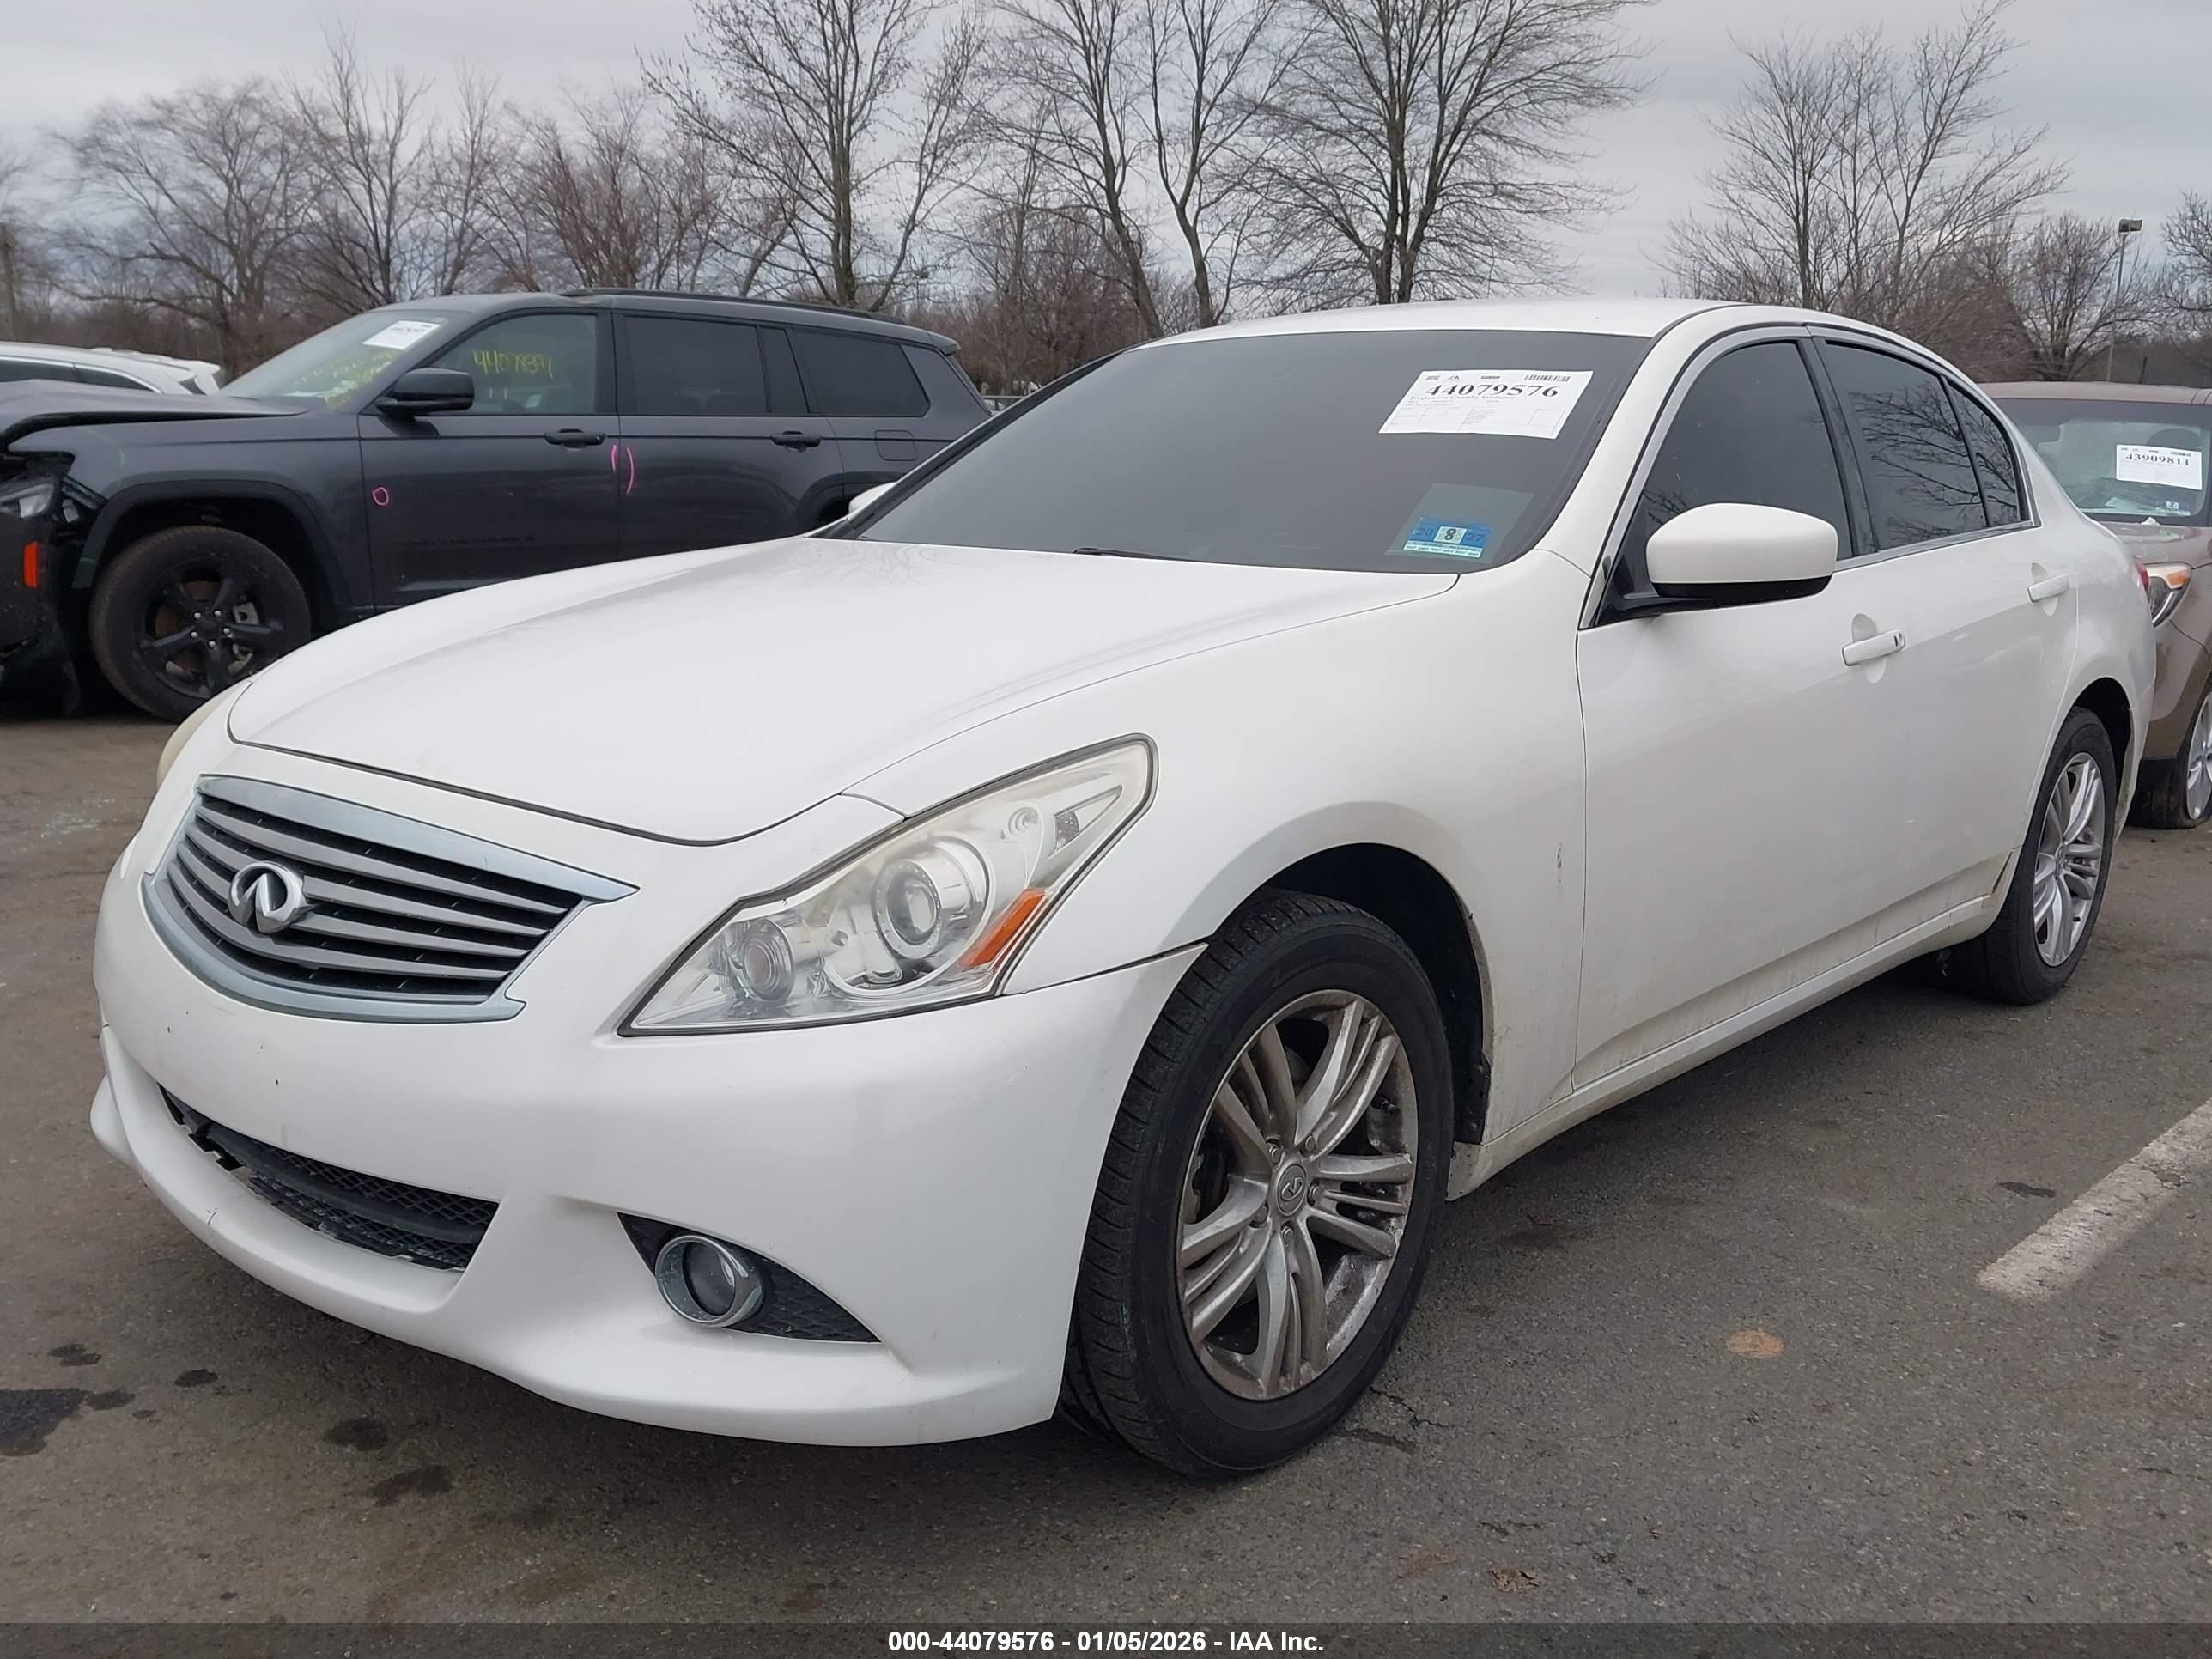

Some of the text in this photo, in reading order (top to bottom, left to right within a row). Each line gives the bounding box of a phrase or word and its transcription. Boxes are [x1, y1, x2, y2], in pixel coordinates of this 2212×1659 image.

[1425, 385, 1559, 398] 44079576
[2125, 453, 2189, 466] 43909811
[1444, 528, 1457, 541] 8
